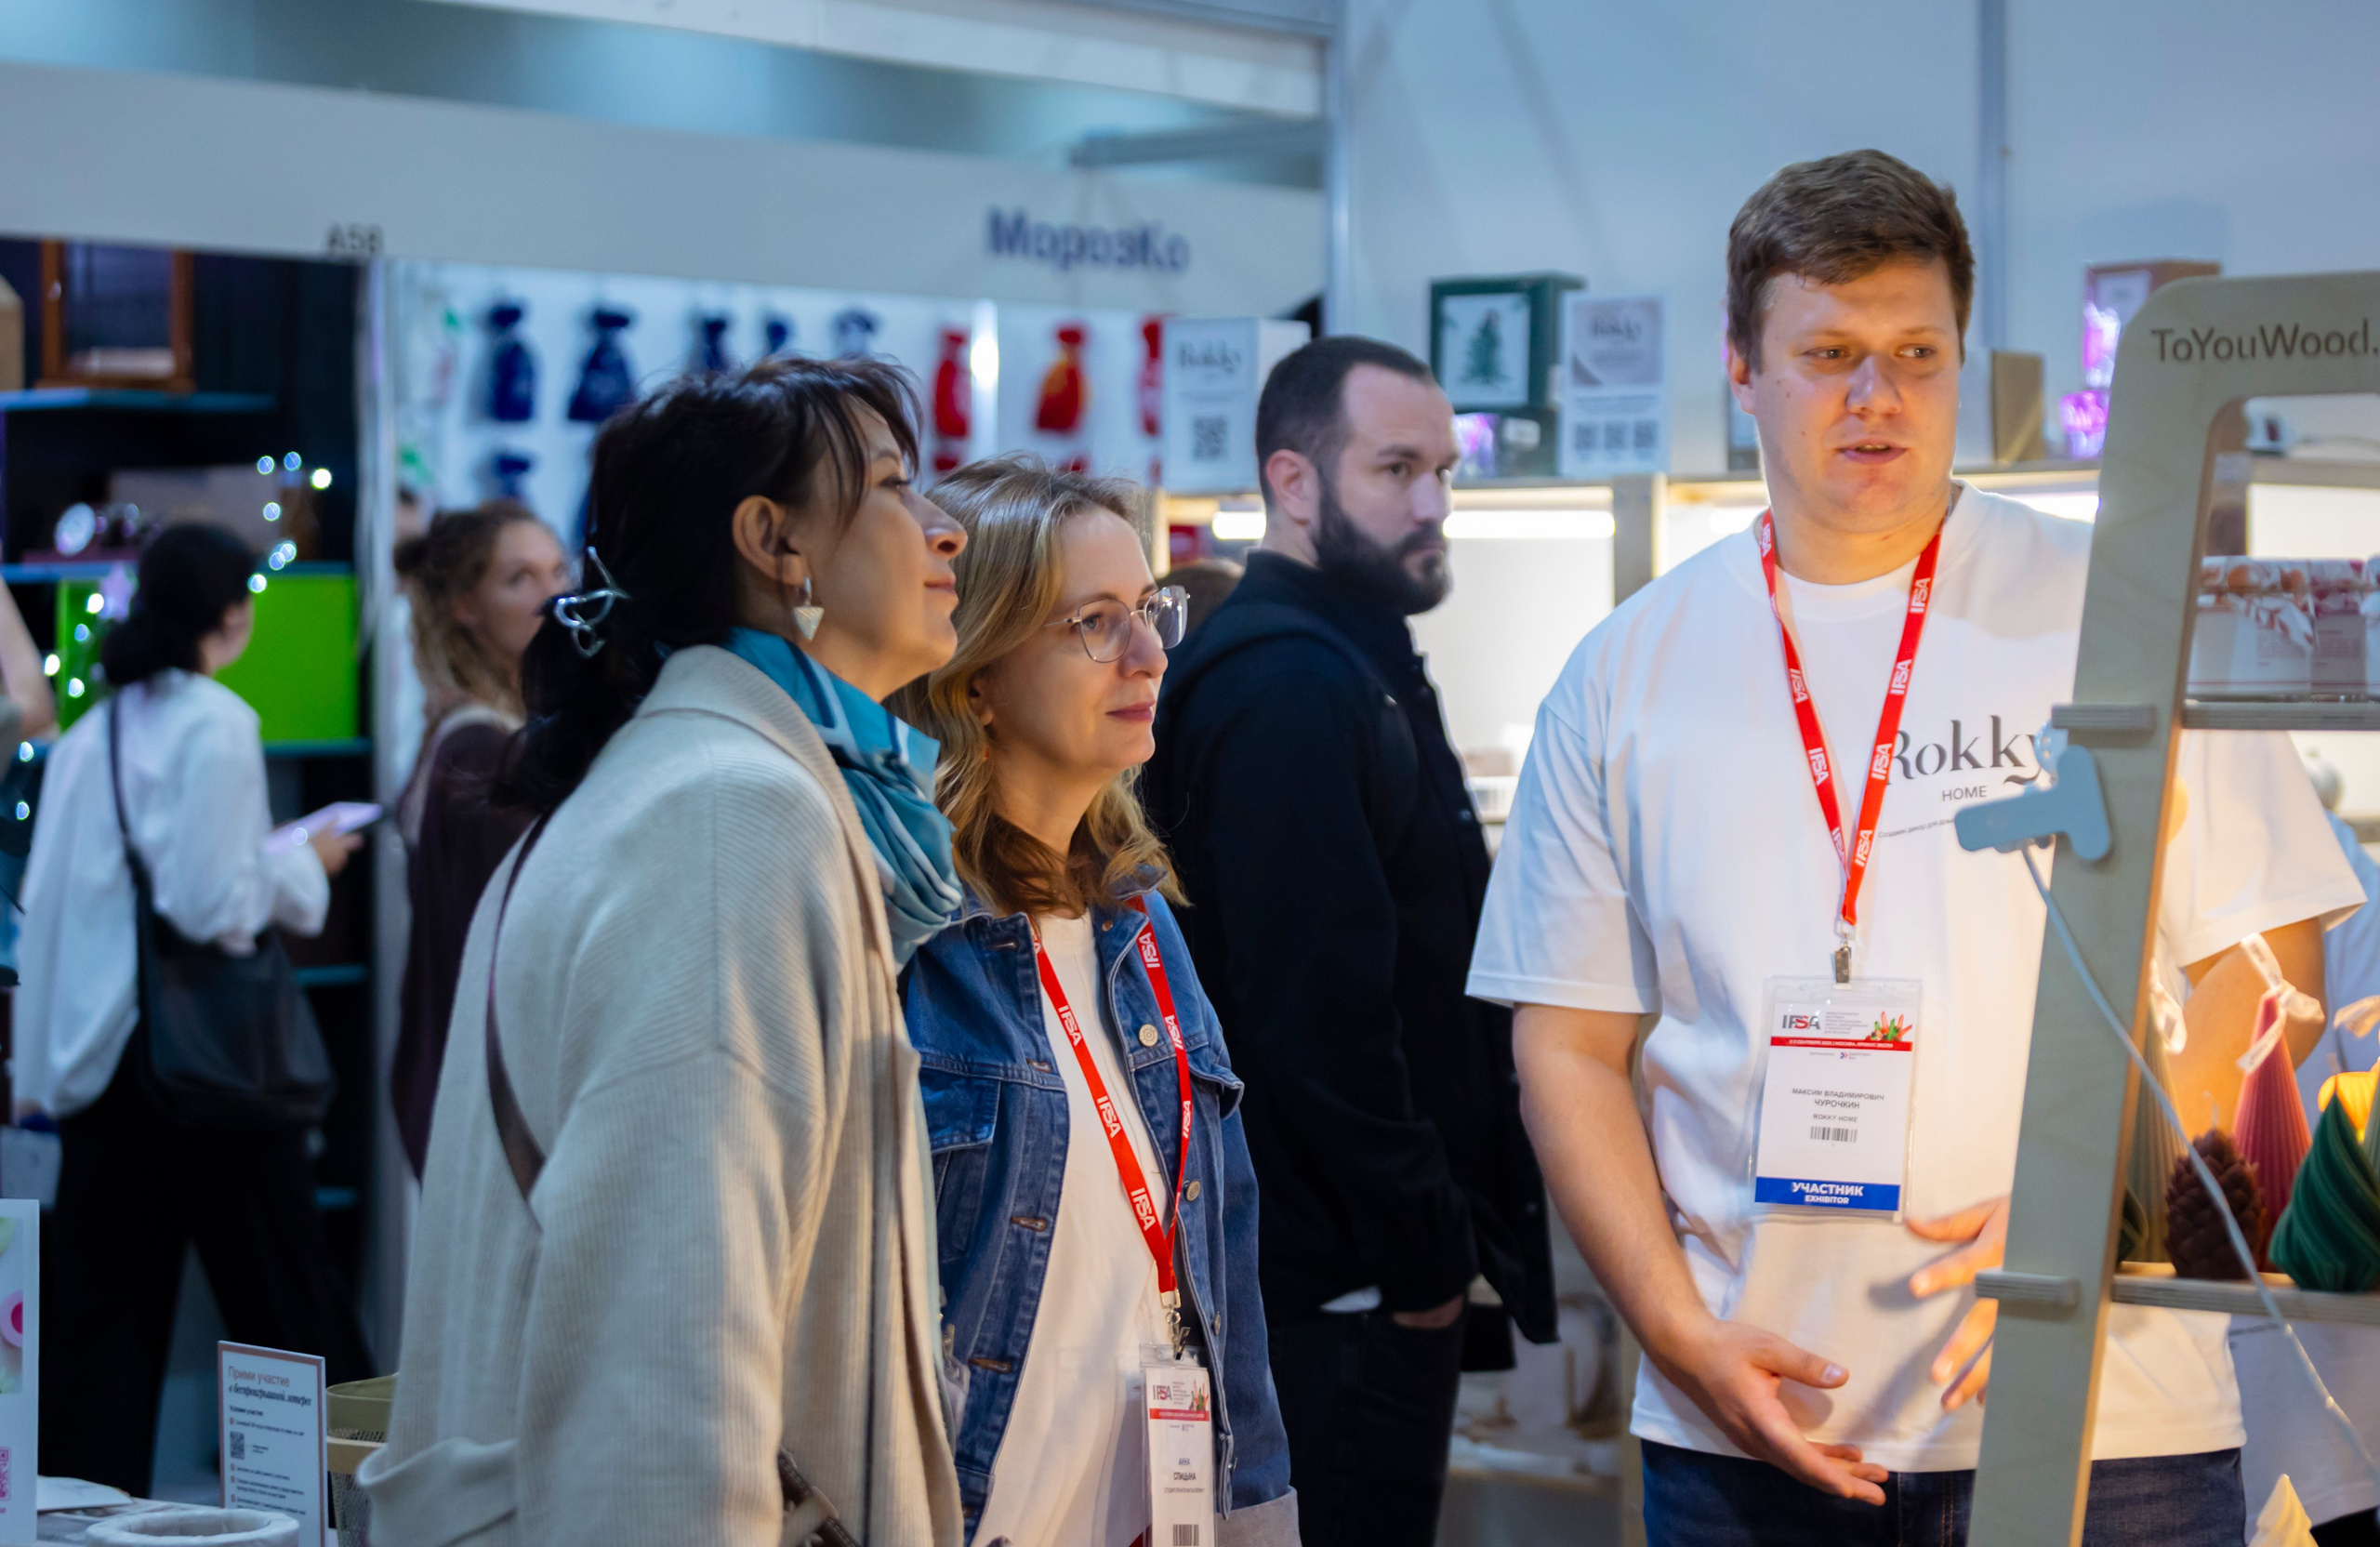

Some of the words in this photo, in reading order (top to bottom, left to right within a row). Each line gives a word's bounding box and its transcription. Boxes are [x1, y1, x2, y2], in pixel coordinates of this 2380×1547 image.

[988, 205, 1189, 273] МорозКо
[1942, 786, 1987, 801] HOME
[1792, 1088, 1822, 1096] МАКСИМ
[1824, 1091, 1884, 1101] ВЛАДИМИРОВИЧ
[1814, 1099, 1860, 1109] ЧУРОЧКИН
[1792, 1182, 1864, 1197] УЧАСТНИК
[1805, 1195, 1849, 1205] EXHIBITOR
[229, 1366, 256, 1382] Прими
[257, 1372, 290, 1387] участие
